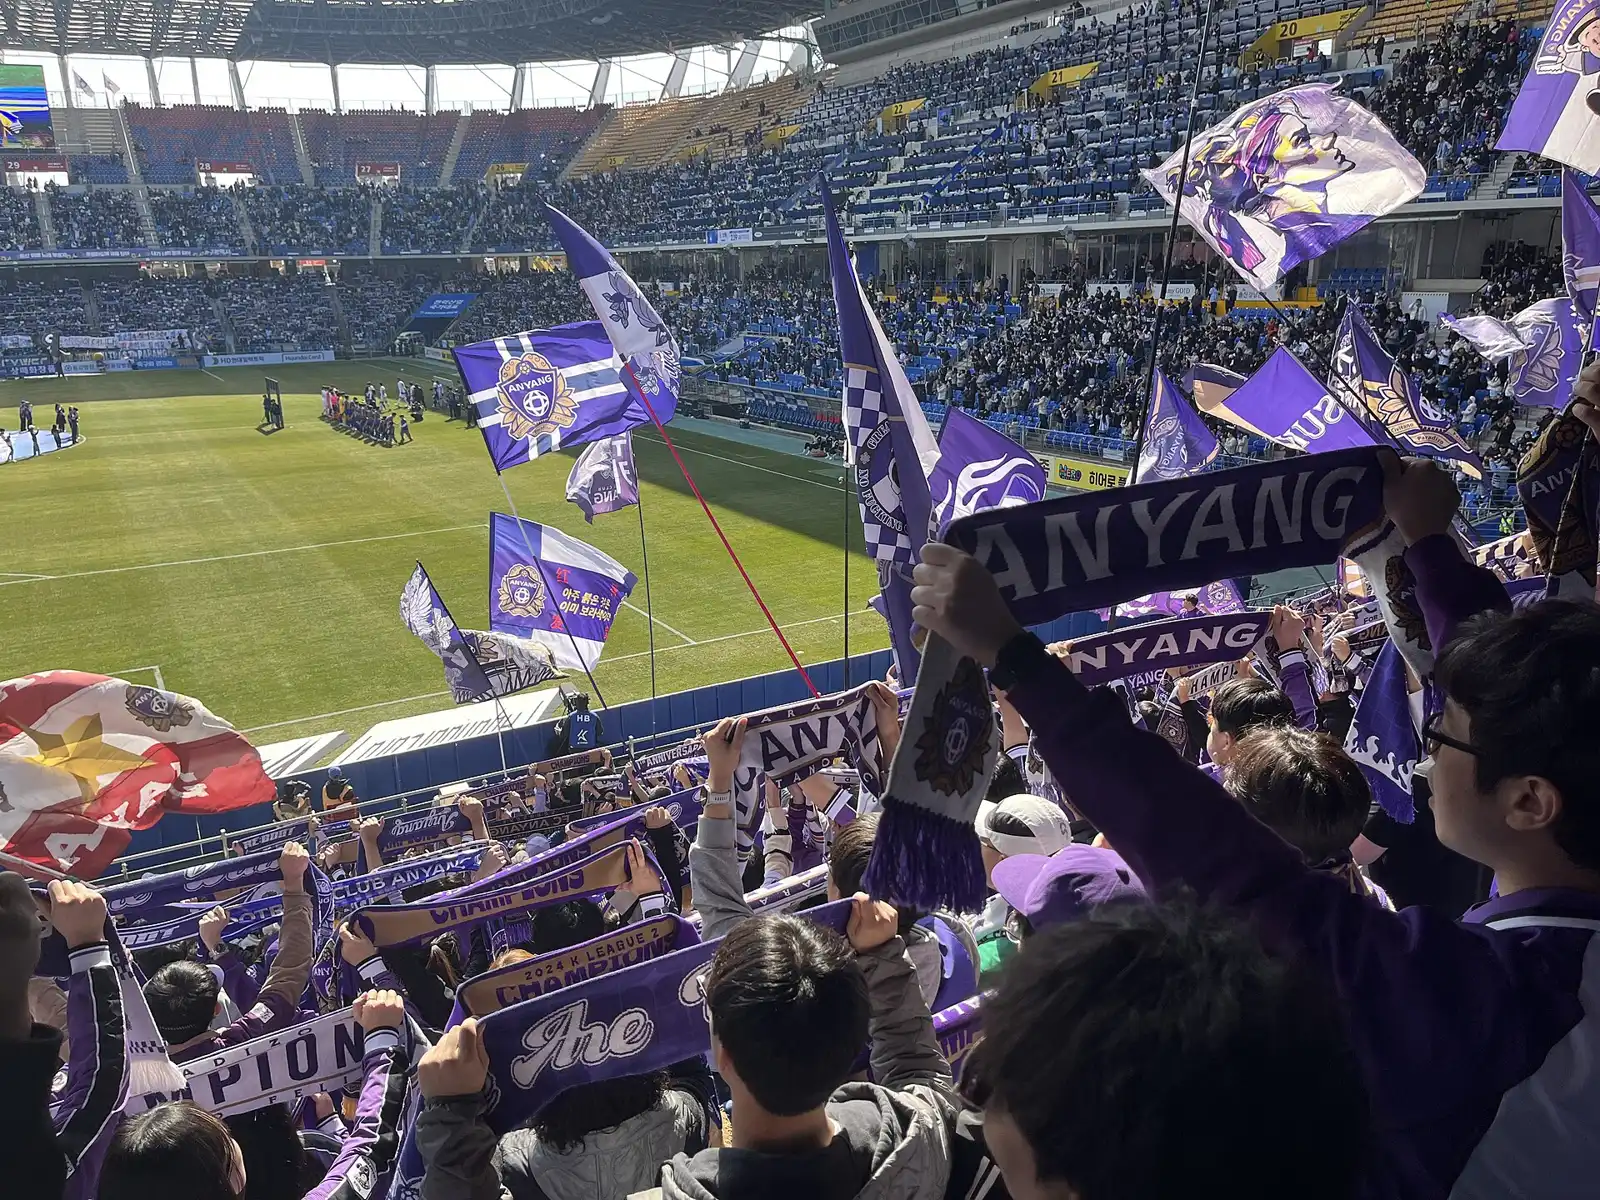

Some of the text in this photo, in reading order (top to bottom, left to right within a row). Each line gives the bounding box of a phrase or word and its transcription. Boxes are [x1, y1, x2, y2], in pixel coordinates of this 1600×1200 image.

[1280, 22, 1297, 37] 20
[1052, 71, 1063, 83] 21
[894, 104, 903, 114] 22
[779, 129, 786, 137] 23
[7, 161, 20, 169] 29
[199, 162, 211, 171] 28
[361, 165, 371, 173] 27
[608, 157, 617, 165] 25
[508, 374, 553, 393] ANYANG
[1089, 470, 1116, 488] 히어로
[858, 468, 902, 532] NO FUCKING
[968, 465, 1367, 602] ANYANG
[509, 579, 537, 589] ANYANG
[562, 588, 580, 602] 아주
[581, 592, 599, 606] 붉은
[559, 601, 580, 615] 이미
[1072, 622, 1260, 674] NYANG
[1128, 669, 1163, 690] YANG
[1190, 664, 1237, 694] HAMPI
[134, 689, 155, 707] ANY
[576, 714, 590, 722] HB
[551, 755, 590, 769] CHAMPIONS
[646, 741, 706, 767] ANNIVERSAR
[333, 879, 386, 900] CLUB
[525, 928, 660, 981] 2024 K LEAGUE 2
